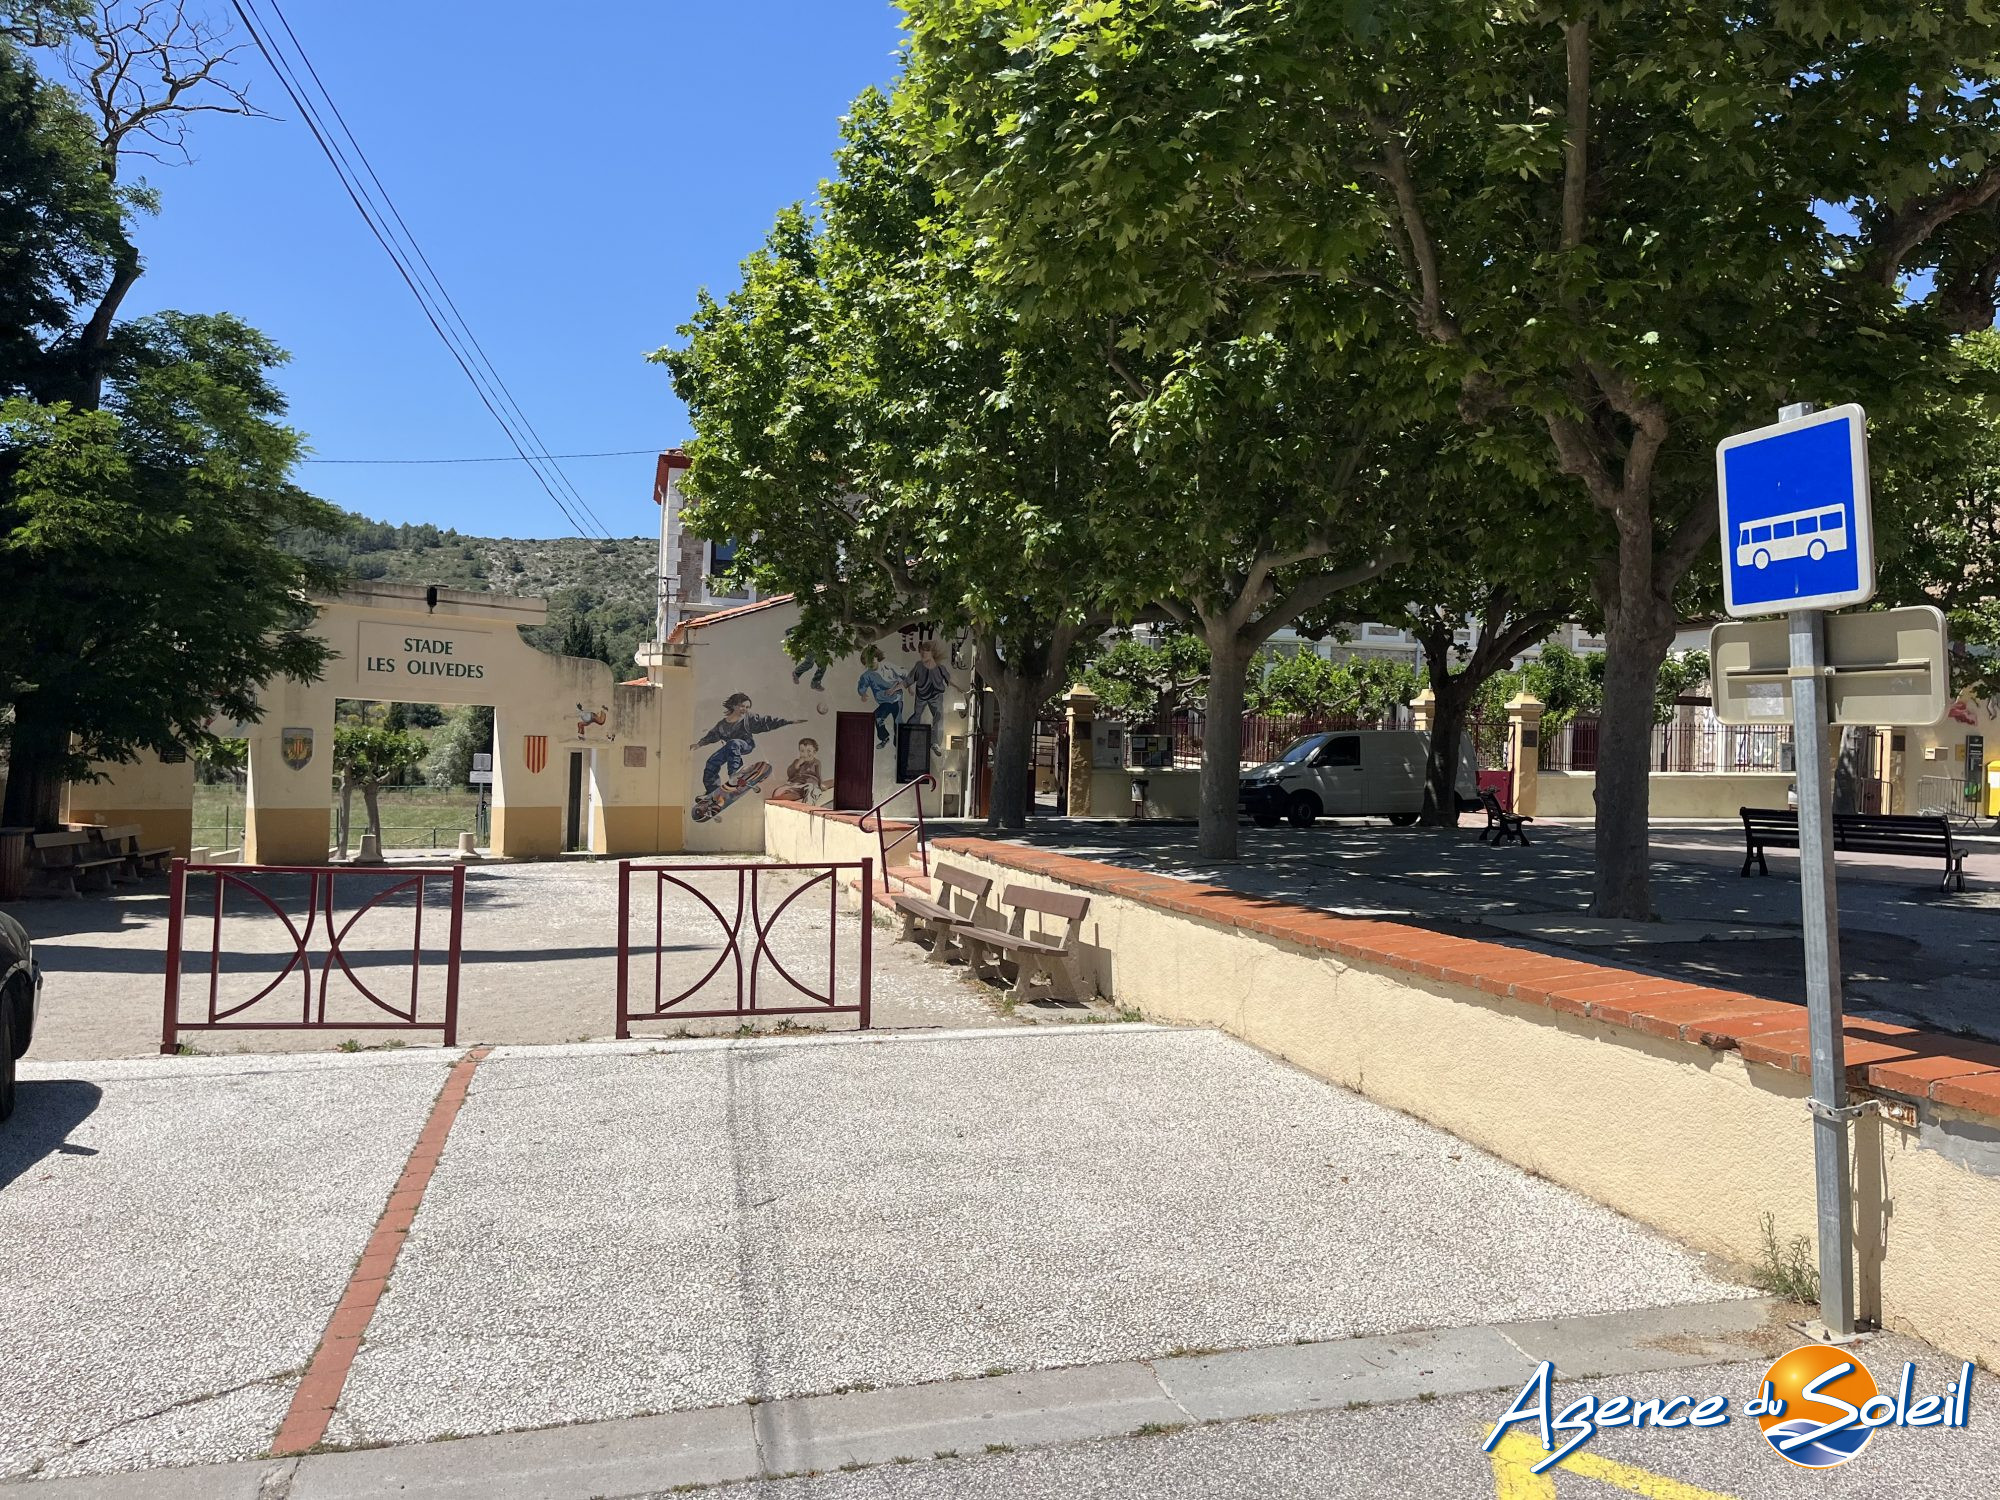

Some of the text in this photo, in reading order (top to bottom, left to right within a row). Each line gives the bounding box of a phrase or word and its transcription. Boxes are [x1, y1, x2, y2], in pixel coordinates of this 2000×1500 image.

[403, 637, 453, 655] STADE
[367, 656, 484, 679] LES OLIVEDES
